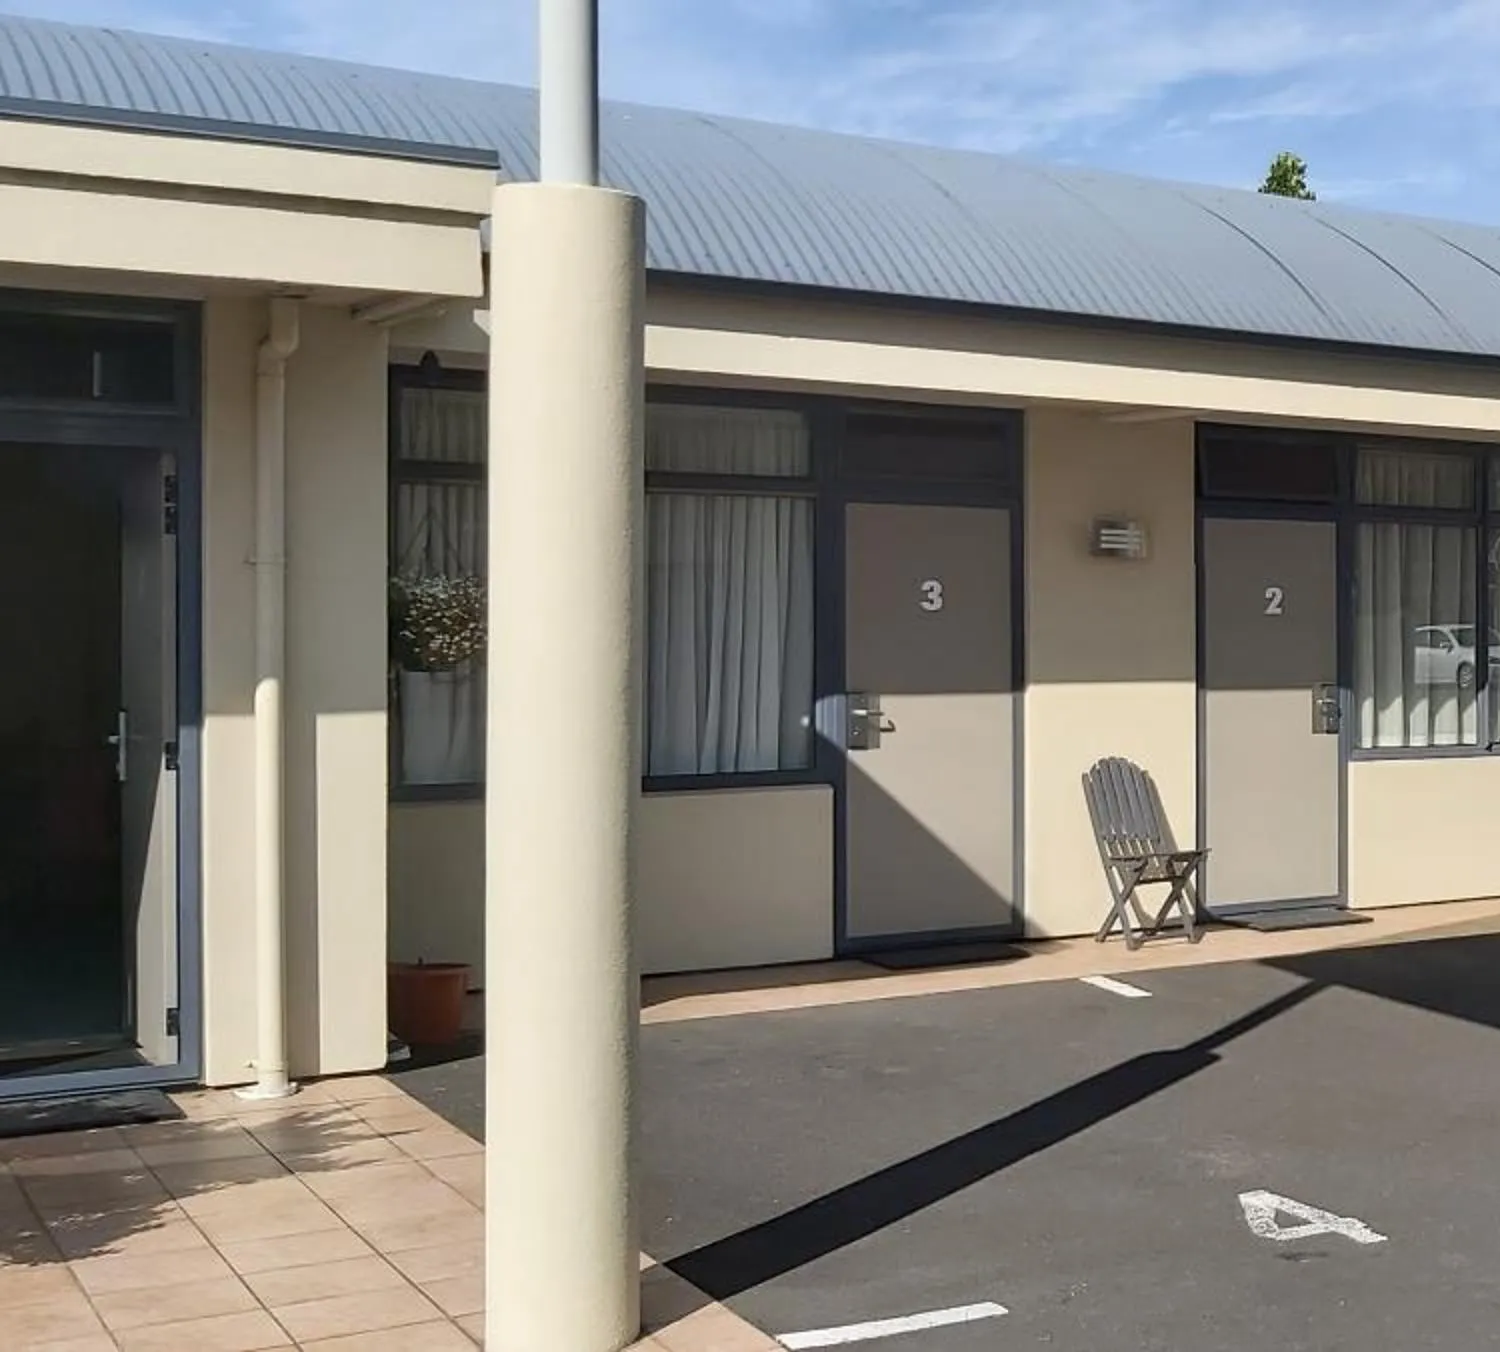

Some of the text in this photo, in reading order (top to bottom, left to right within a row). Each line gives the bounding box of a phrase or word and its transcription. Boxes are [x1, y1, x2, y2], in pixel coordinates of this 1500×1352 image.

[920, 579, 943, 611] 3
[1264, 586, 1283, 615] 2
[1237, 1189, 1389, 1245] 4
